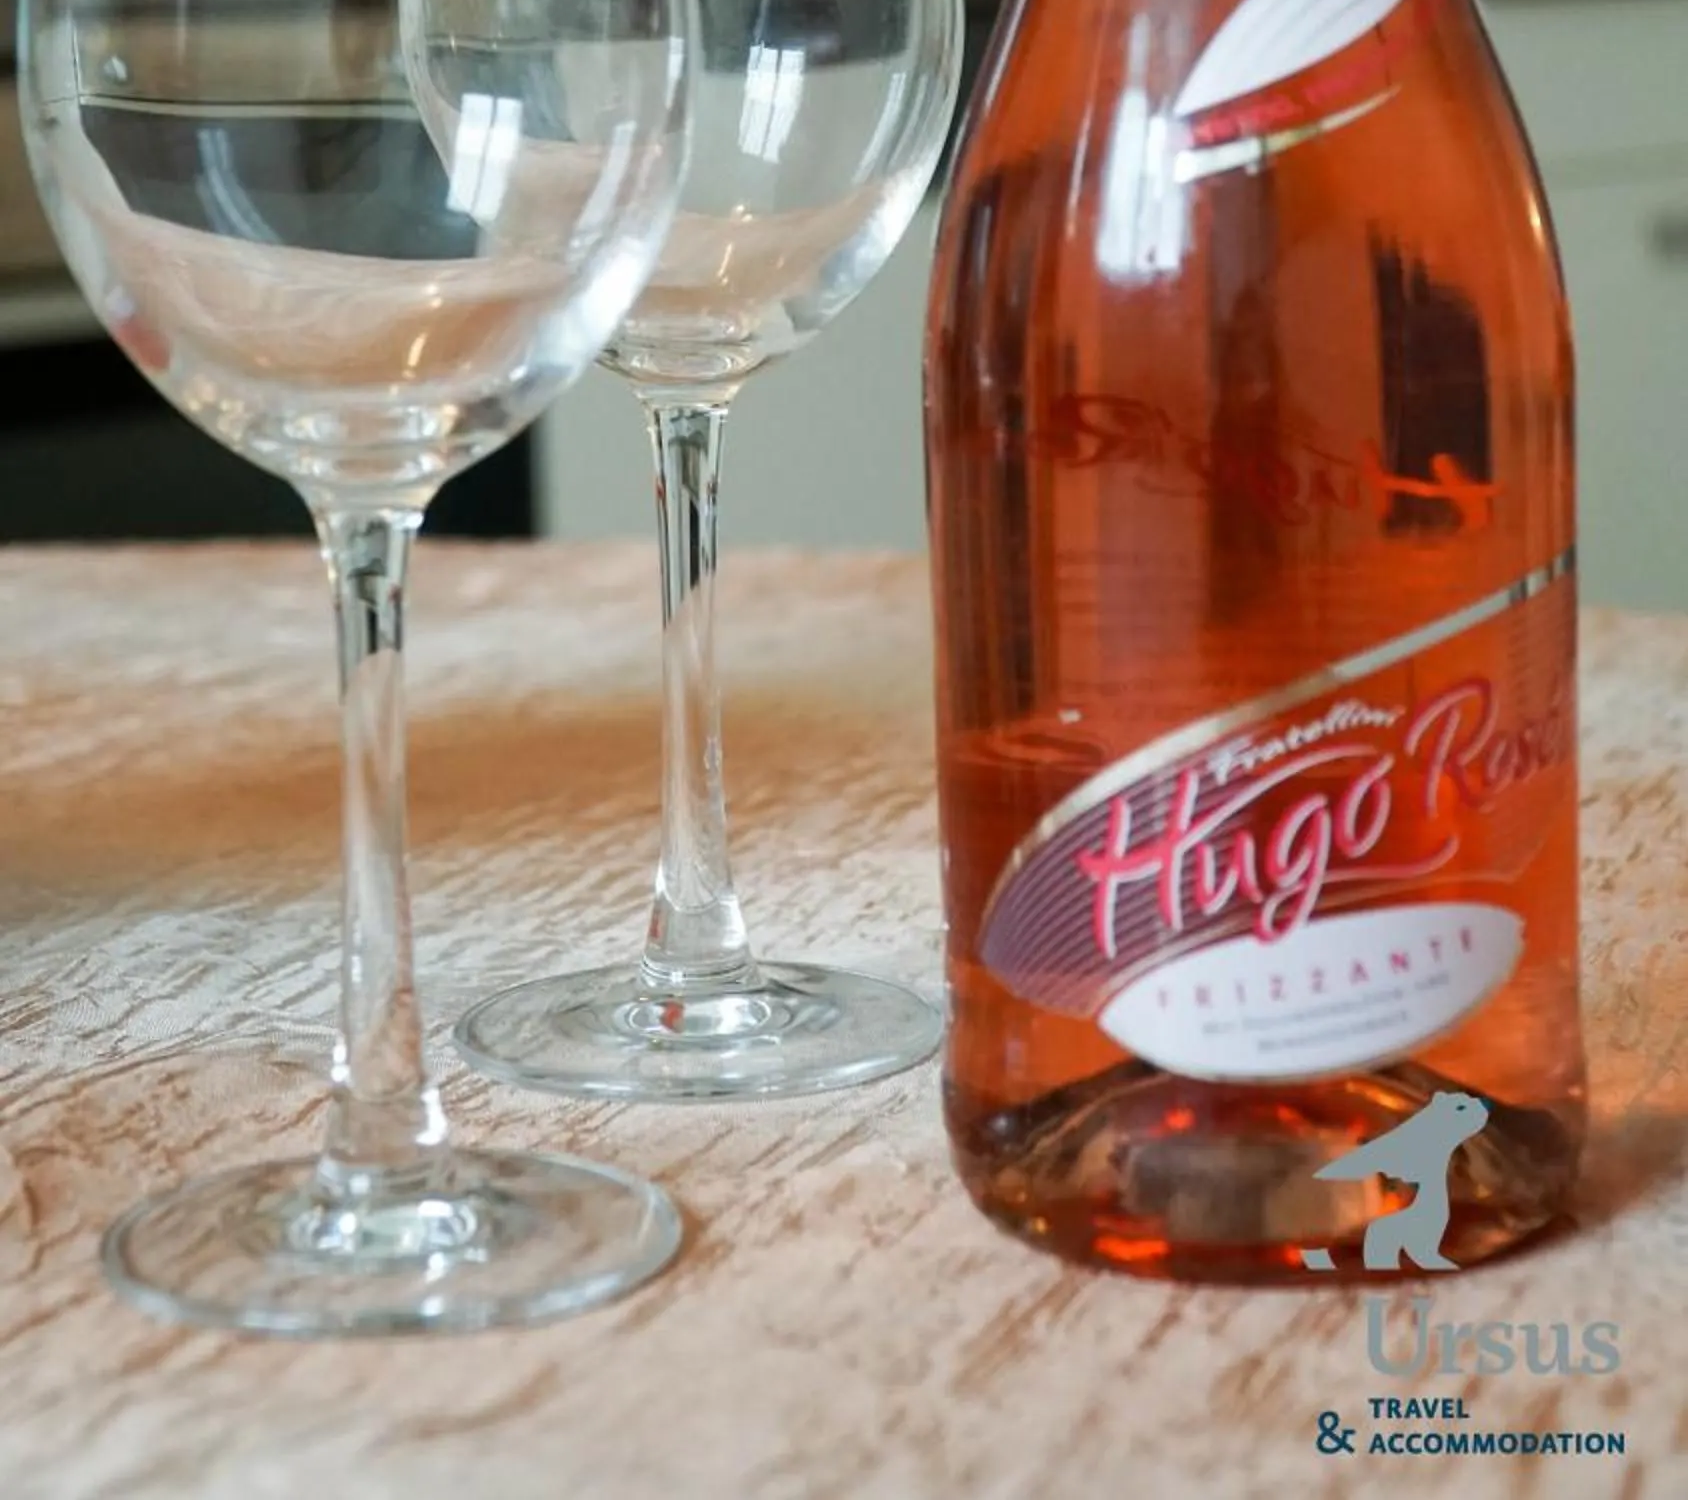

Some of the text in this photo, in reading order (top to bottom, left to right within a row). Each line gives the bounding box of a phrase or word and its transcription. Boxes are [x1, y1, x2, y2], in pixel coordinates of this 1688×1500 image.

[1206, 698, 1406, 786] Fratellini
[1075, 745, 1395, 959] Hugo
[1156, 923, 1475, 1010] FRIZZANTE
